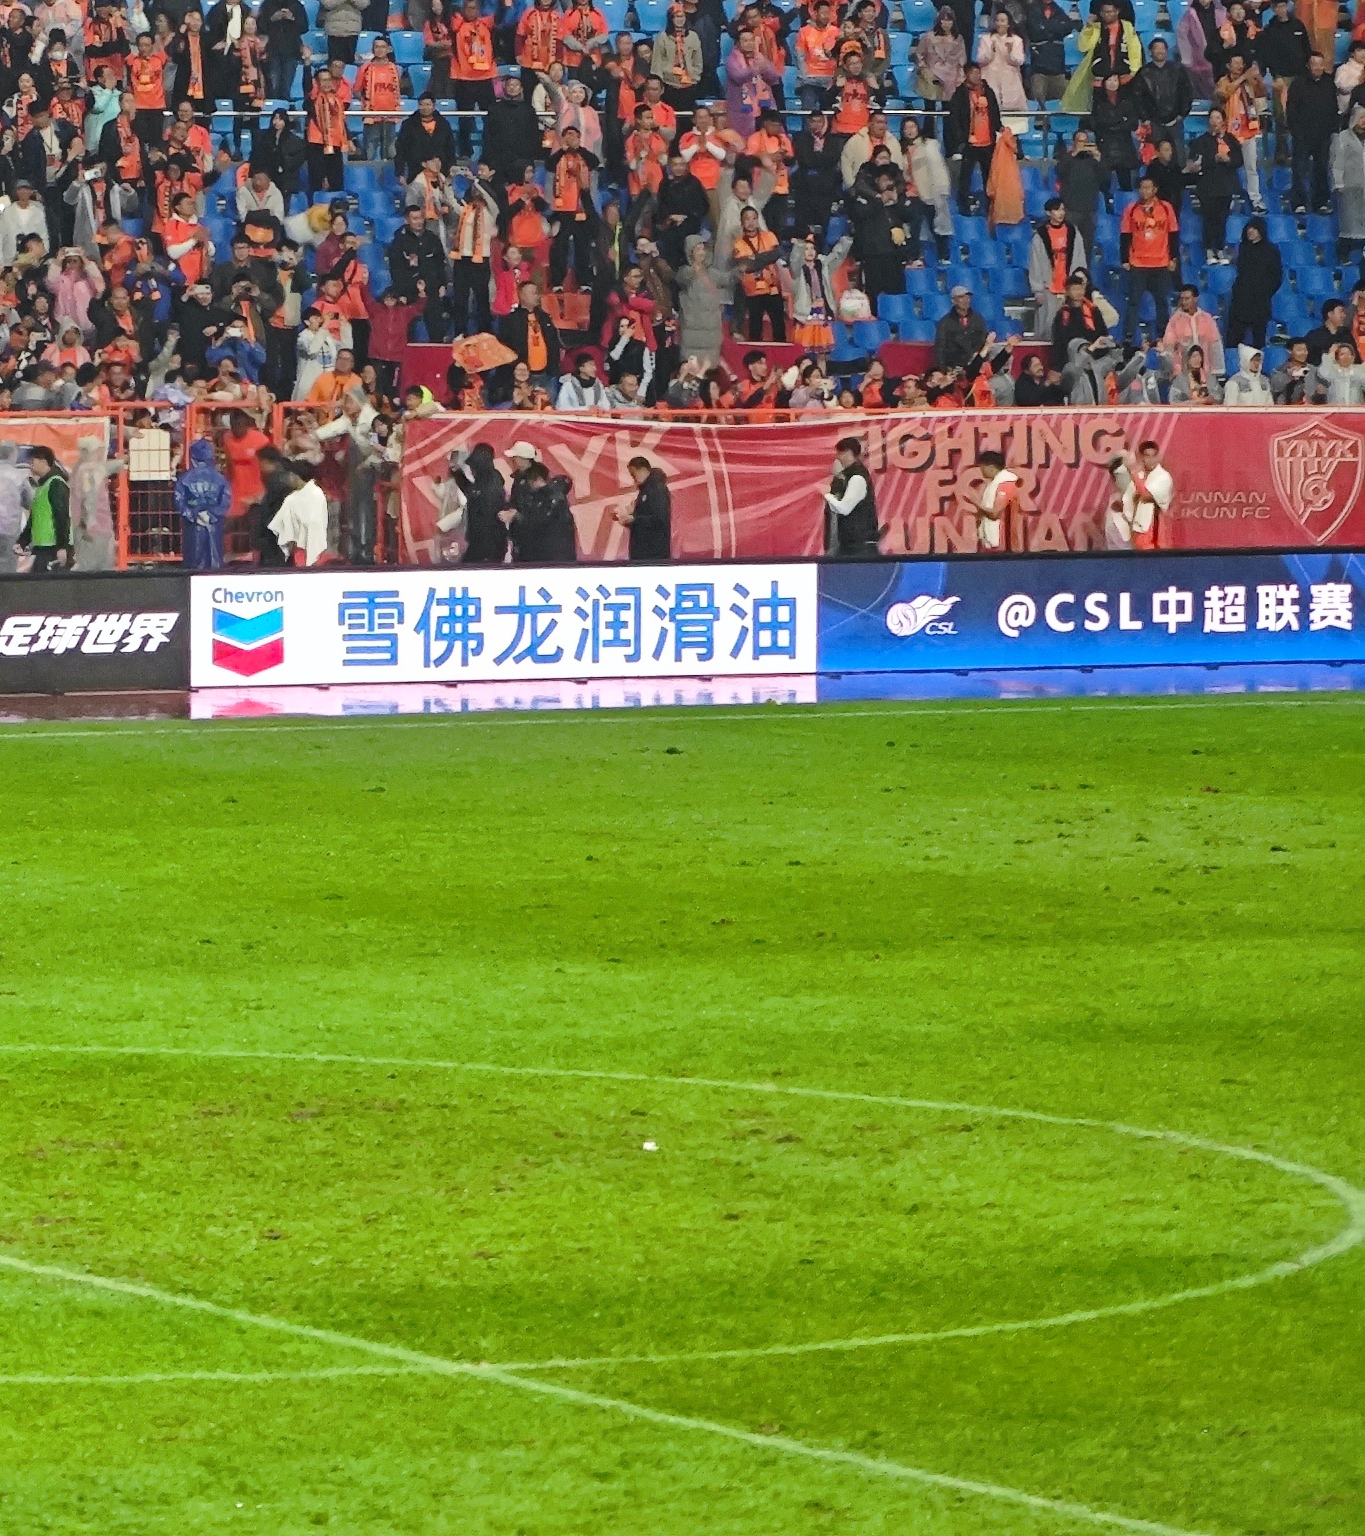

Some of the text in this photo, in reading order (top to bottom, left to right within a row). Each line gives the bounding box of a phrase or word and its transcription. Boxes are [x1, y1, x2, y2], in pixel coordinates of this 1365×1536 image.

[1278, 439, 1357, 458] YNYK
[1241, 506, 1271, 520] FC
[212, 586, 285, 605] Chevron
[997, 582, 1355, 639] @CSL中超联赛
[337, 579, 798, 670] 雪佛龙润滑油
[925, 621, 959, 636] CSL
